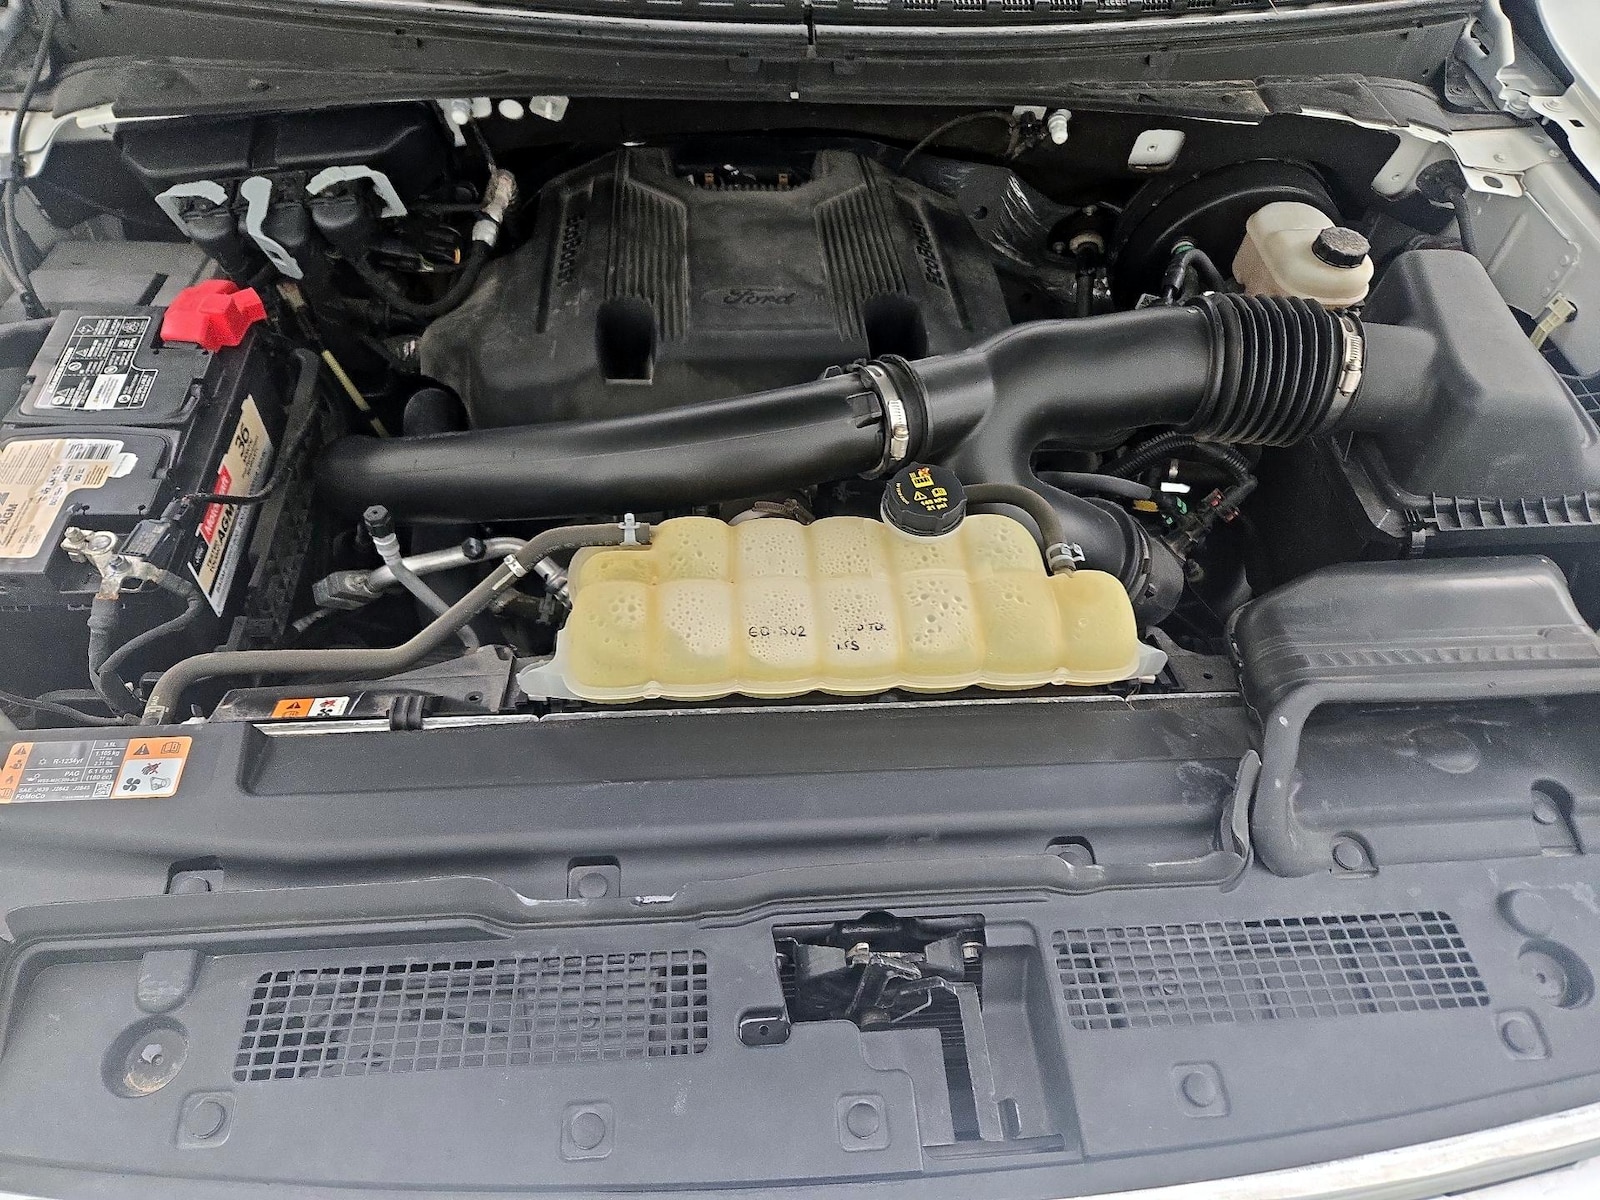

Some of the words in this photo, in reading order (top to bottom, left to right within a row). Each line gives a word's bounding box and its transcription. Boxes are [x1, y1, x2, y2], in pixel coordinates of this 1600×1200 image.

[911, 219, 946, 290] EcoBoost
[723, 288, 797, 305] Ford
[234, 422, 250, 458] 36
[0, 503, 18, 525] AGM
[217, 502, 235, 544] AGM
[14, 792, 45, 800] FoMoCo
